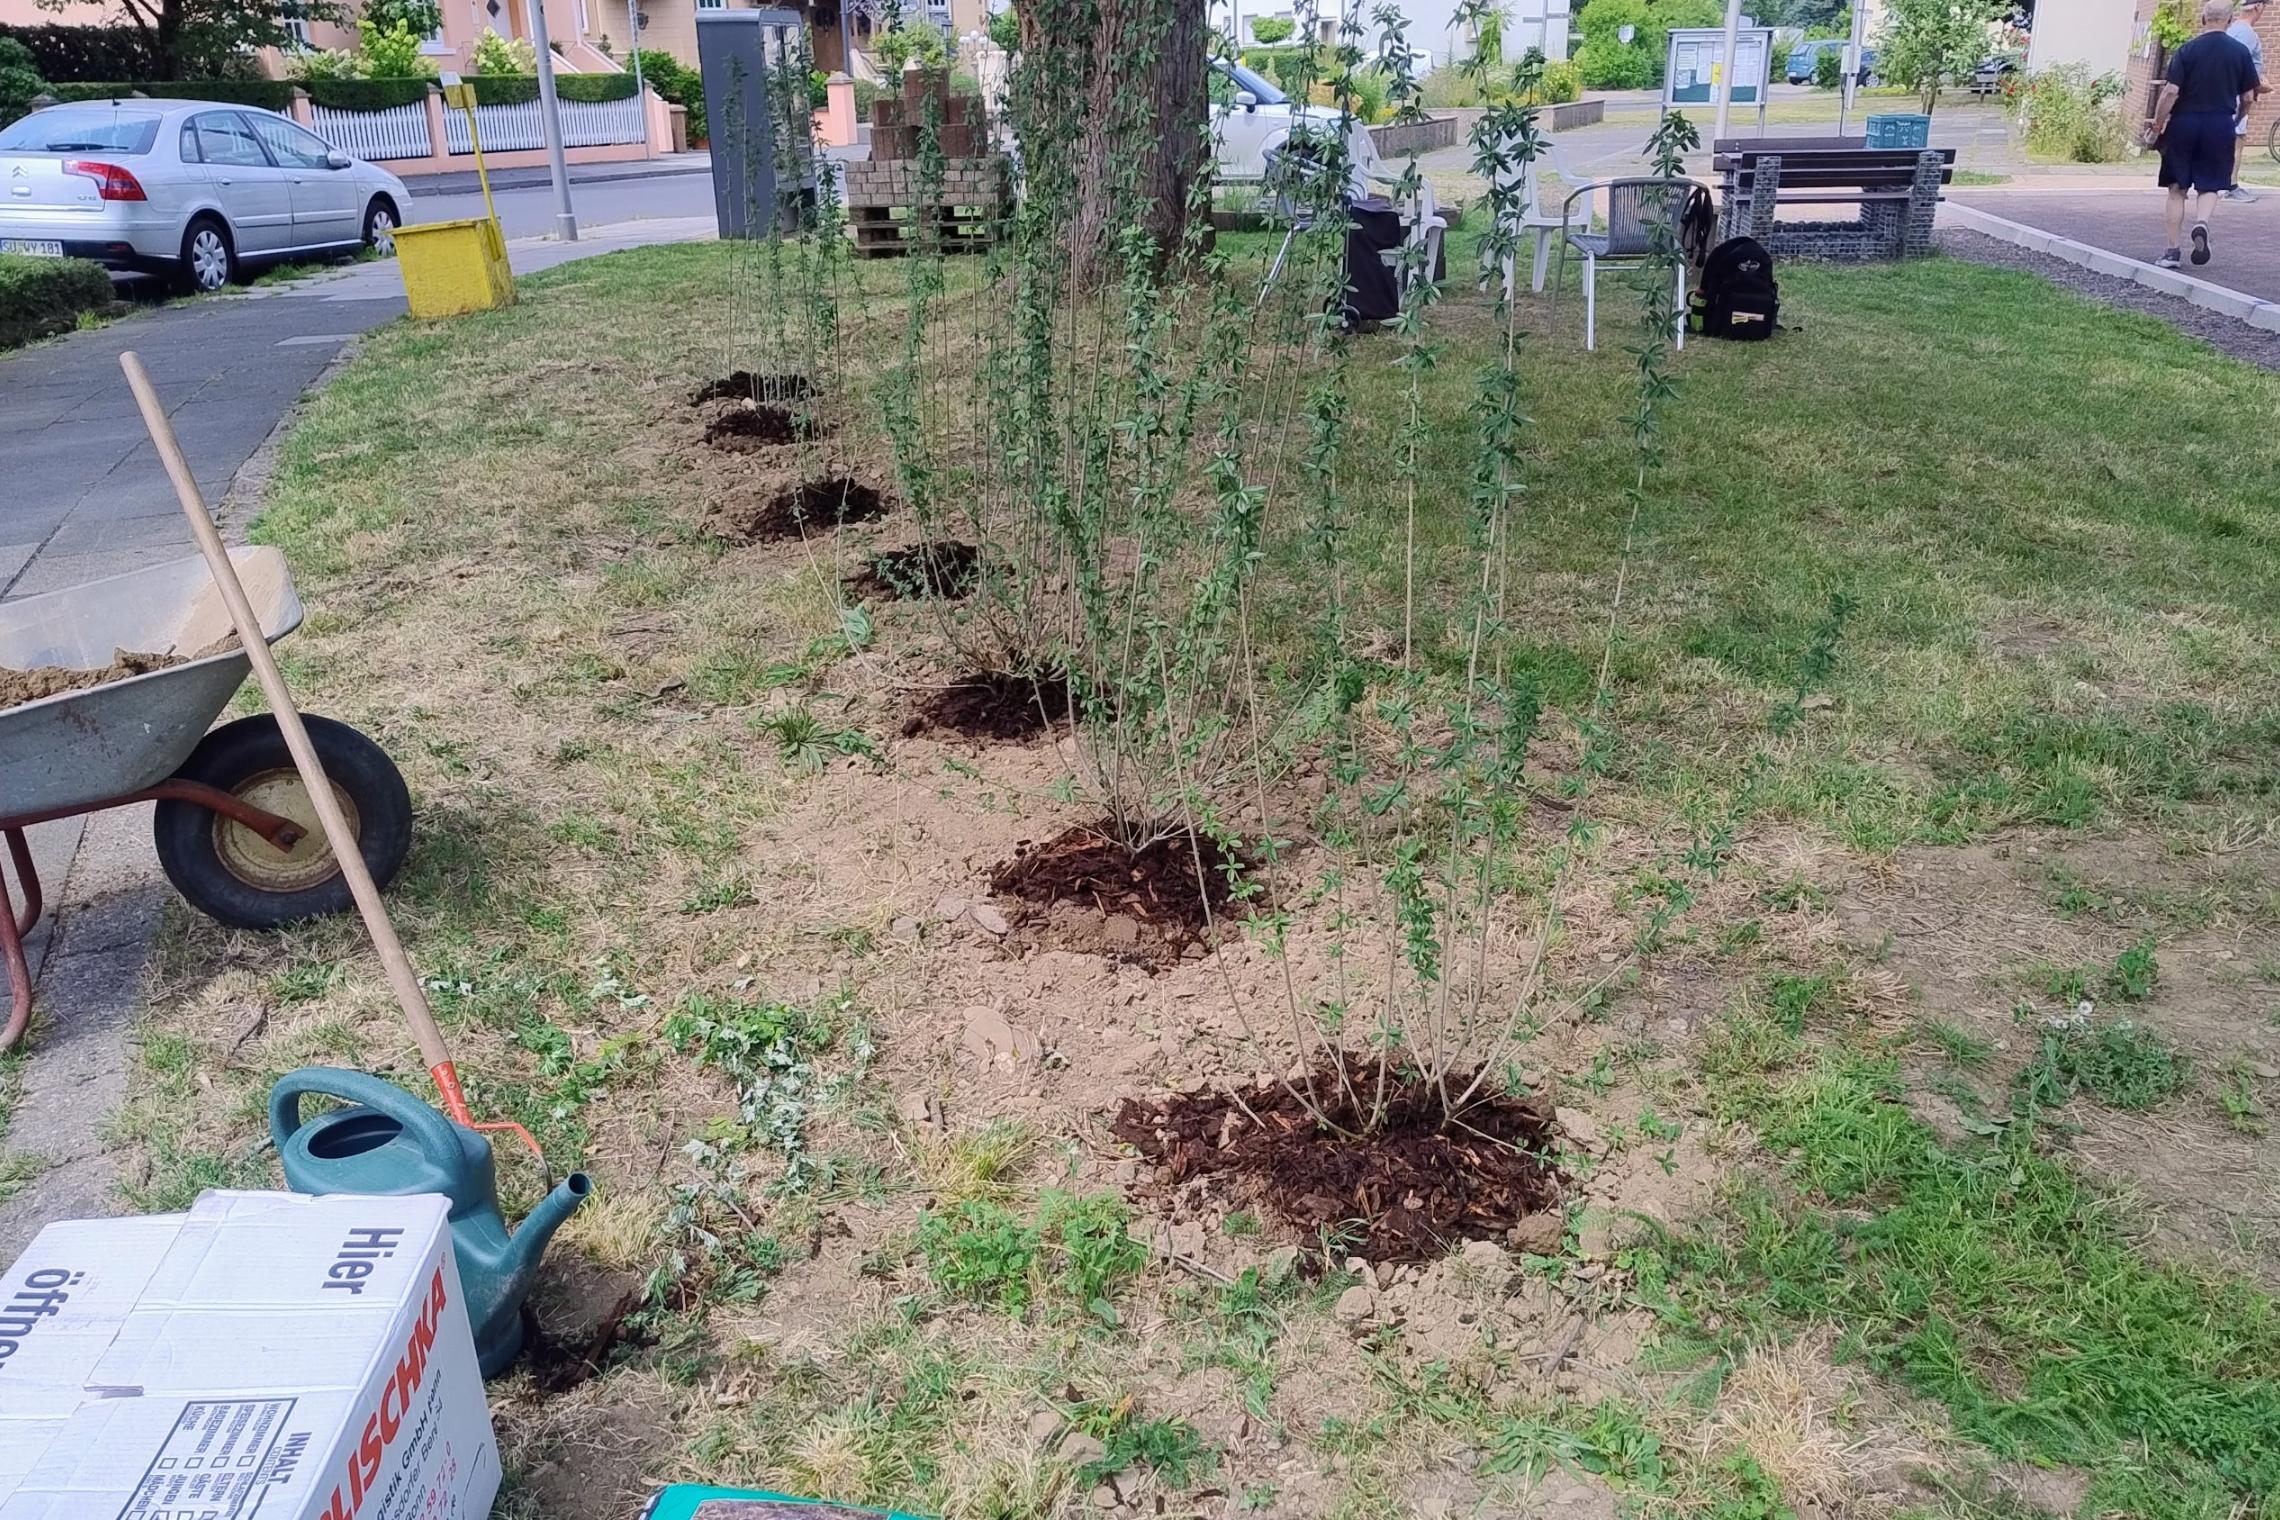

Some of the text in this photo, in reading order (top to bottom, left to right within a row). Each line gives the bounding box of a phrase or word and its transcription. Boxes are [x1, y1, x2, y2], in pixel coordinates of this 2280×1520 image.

[40, 242, 60, 254] 181
[322, 1228, 405, 1294] Hier
[0, 1269, 86, 1370] Öffn
[320, 1265, 447, 1520] LISCHKA
[268, 1432, 312, 1484] INHALT
[402, 1410, 428, 1470] GmbH
[162, 1474, 187, 1504] JUNGEN
[189, 1473, 212, 1498] GÄSTE
[210, 1472, 234, 1501] ELTERN
